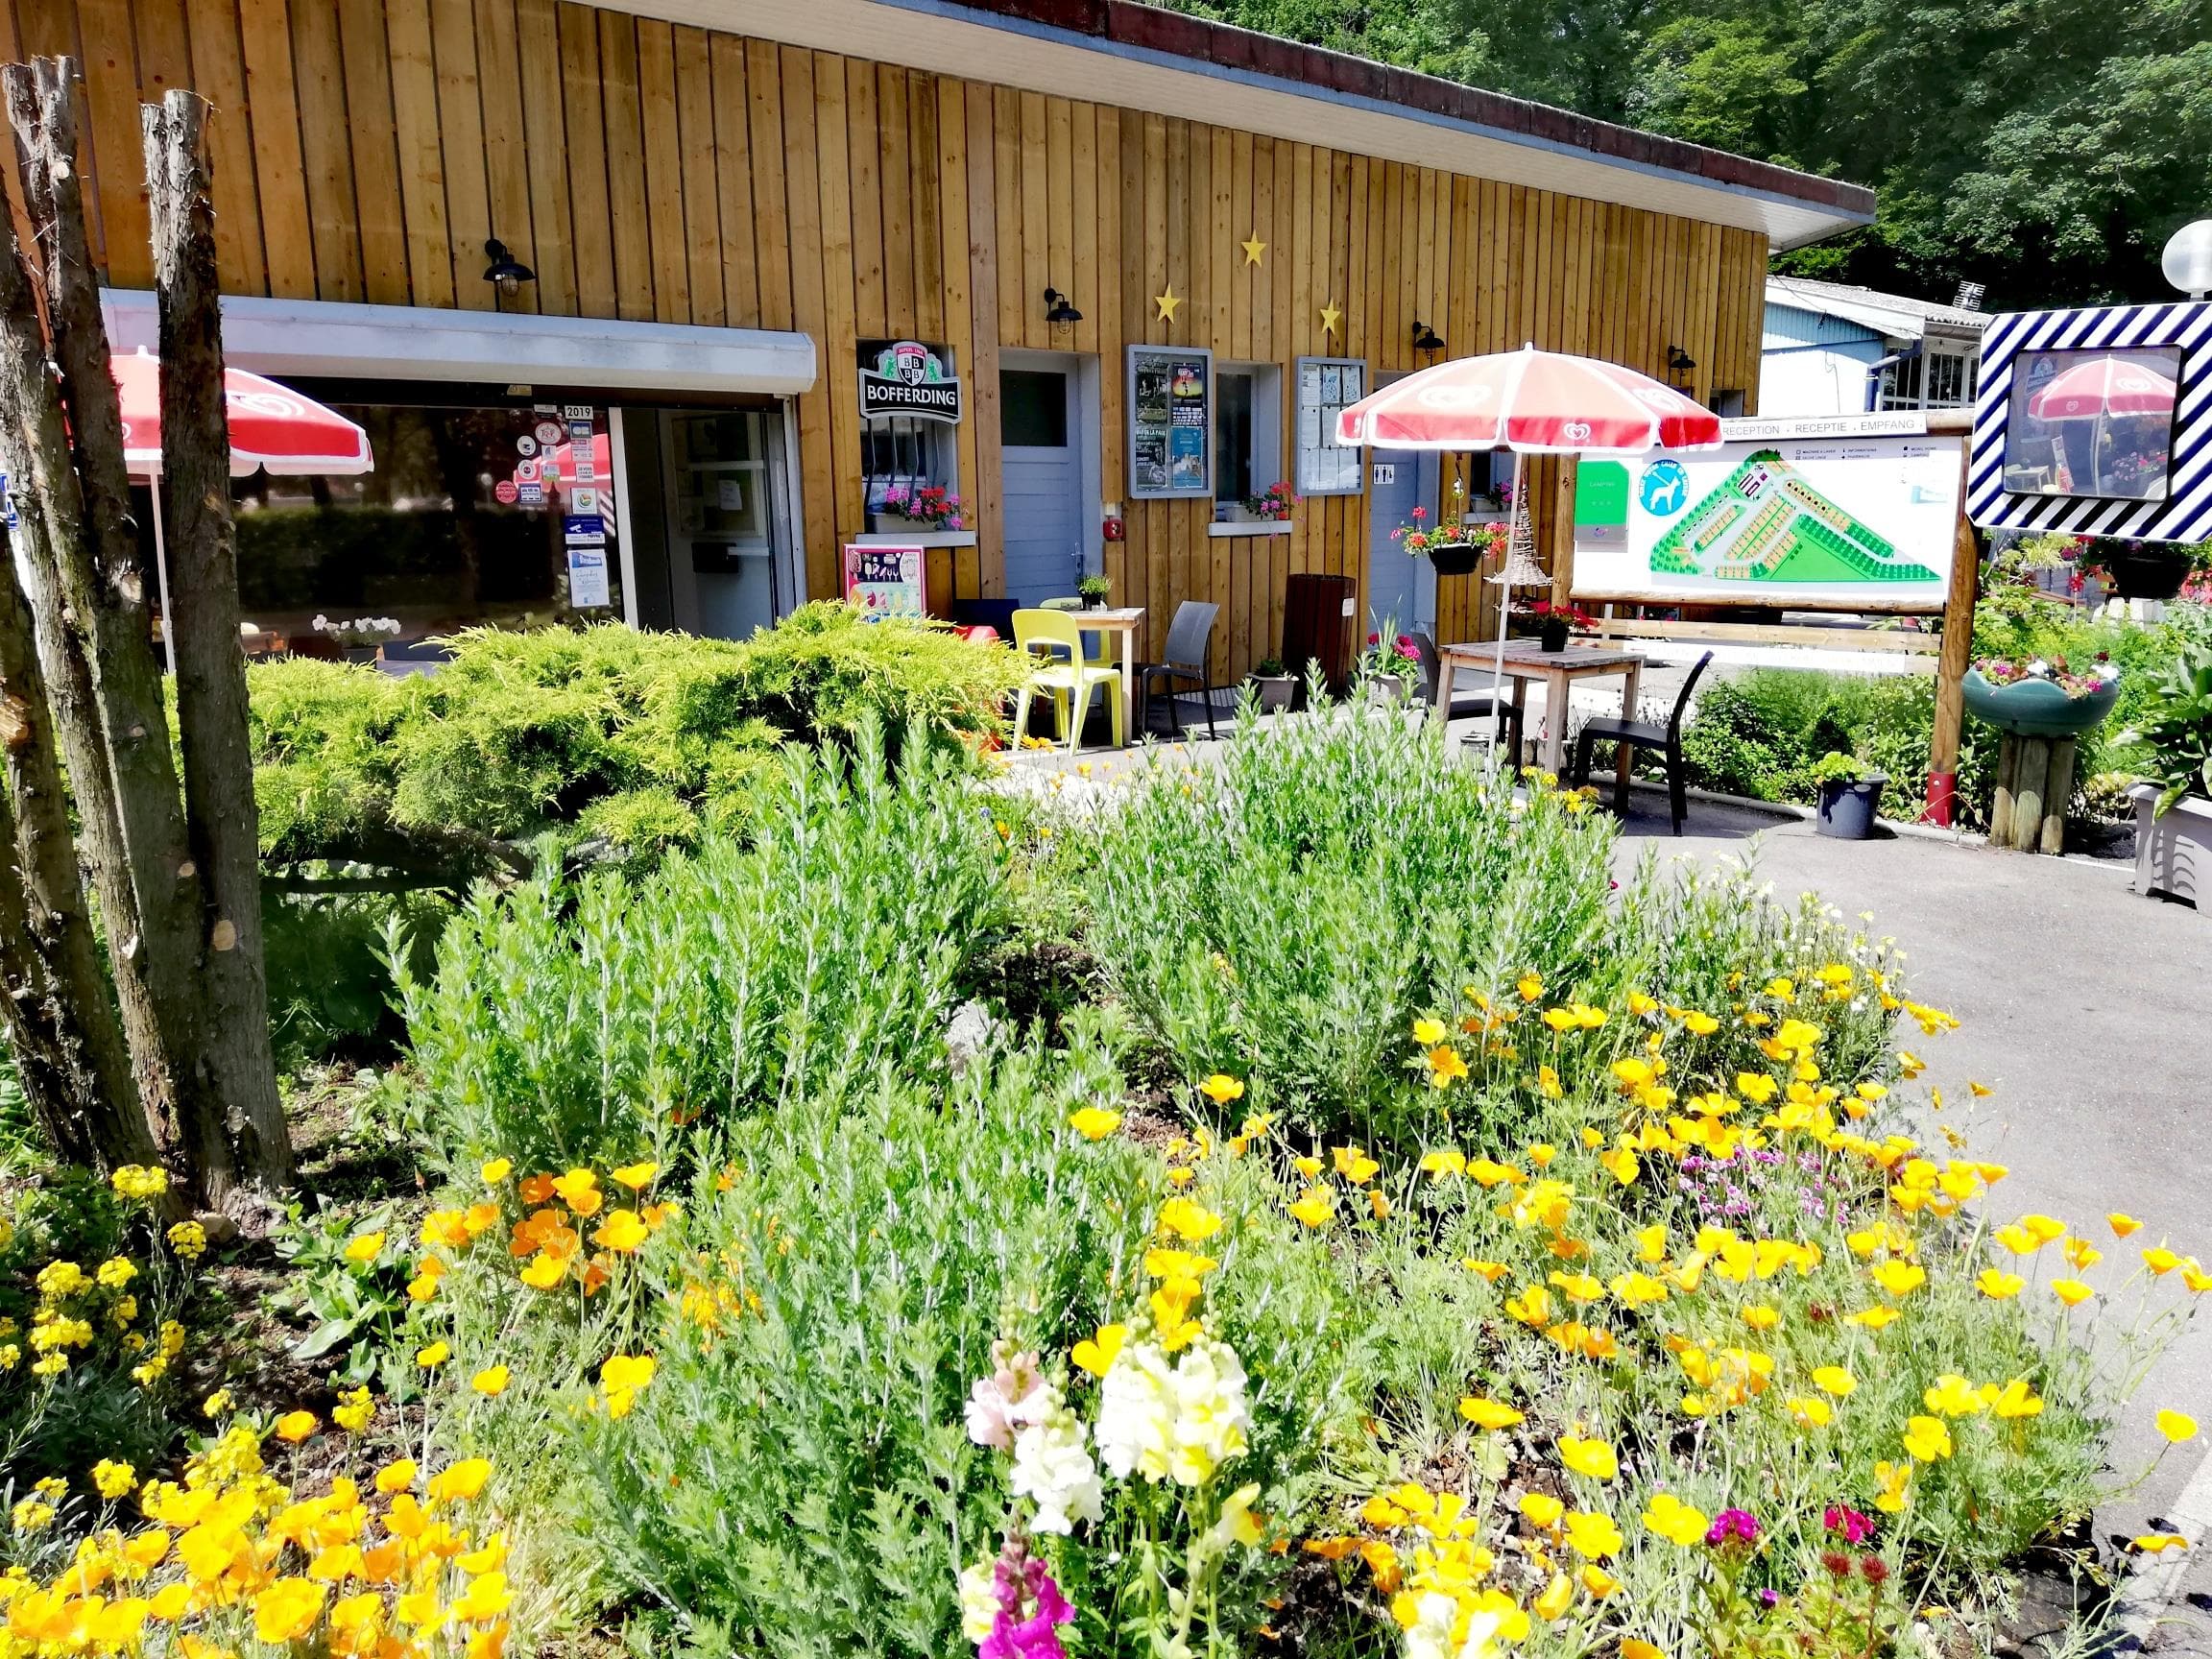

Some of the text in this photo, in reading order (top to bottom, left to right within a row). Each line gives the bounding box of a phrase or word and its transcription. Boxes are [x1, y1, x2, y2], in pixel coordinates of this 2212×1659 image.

[867, 384, 956, 406] BOFFERDING
[567, 407, 590, 417] 2019
[1722, 421, 1914, 436] RECEPTION RECEPTIE EMPFANG
